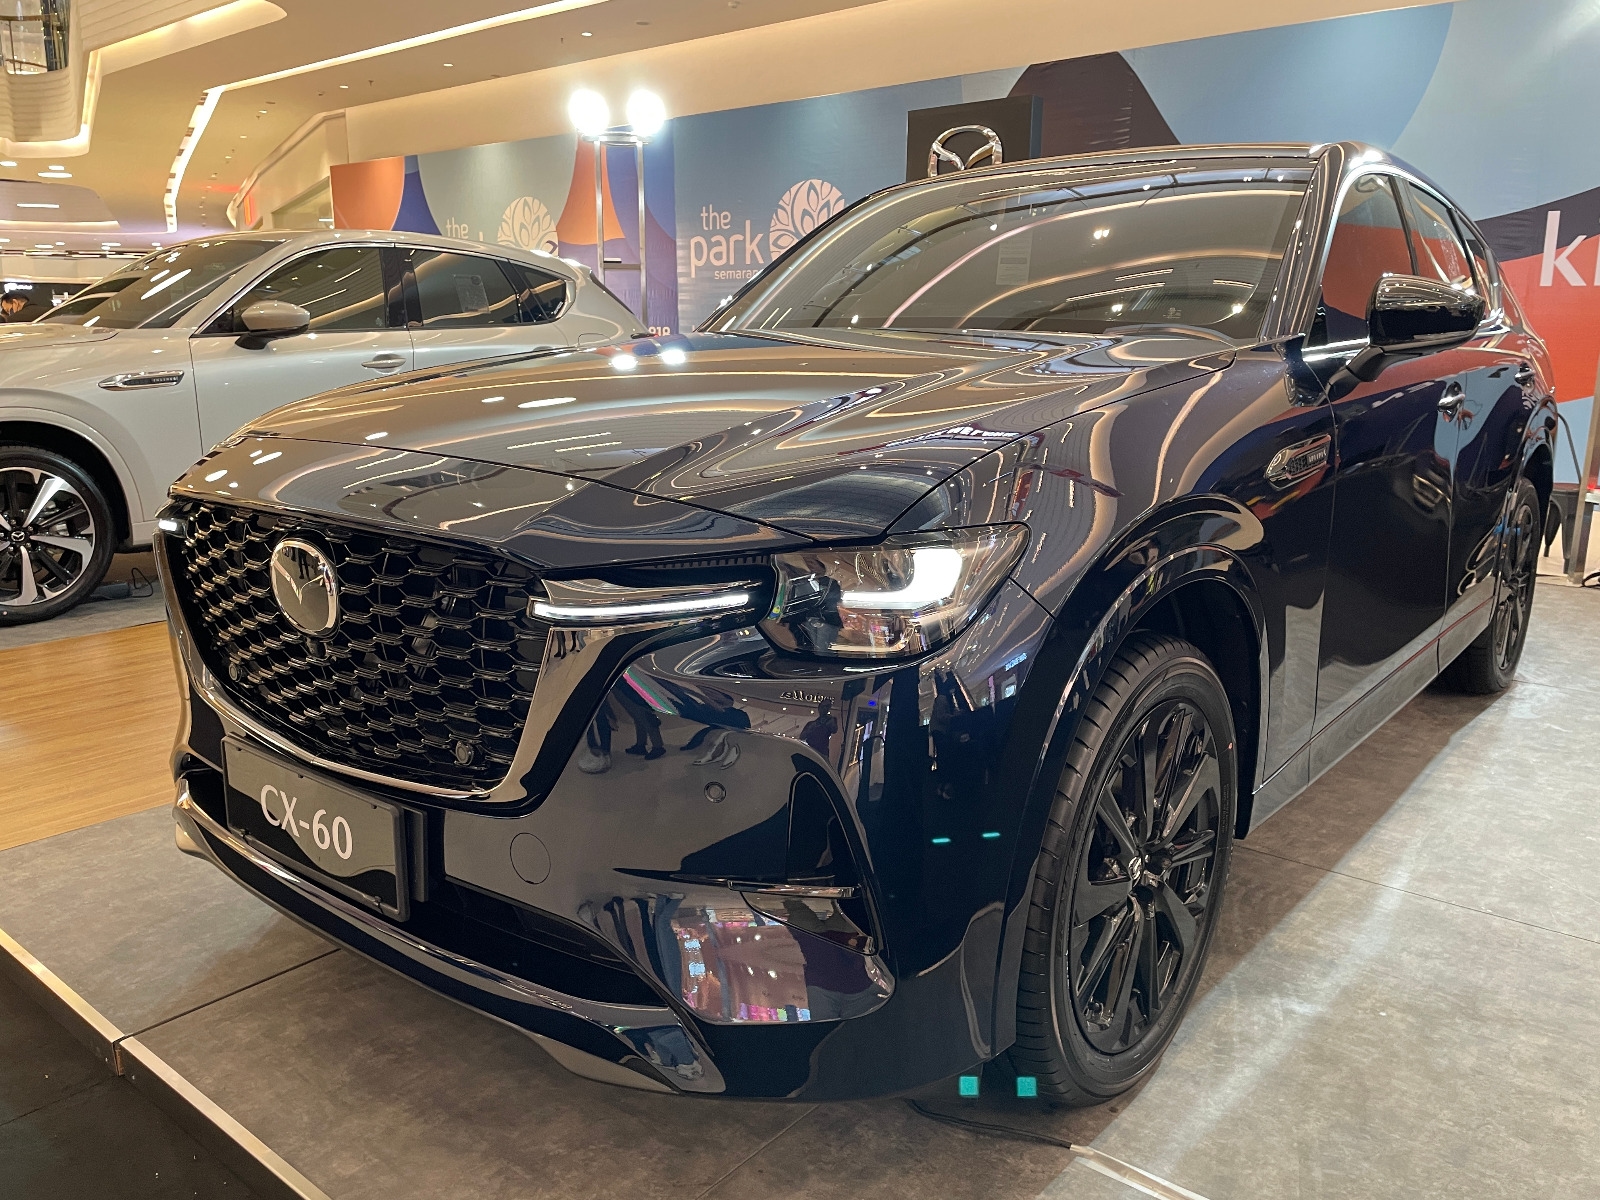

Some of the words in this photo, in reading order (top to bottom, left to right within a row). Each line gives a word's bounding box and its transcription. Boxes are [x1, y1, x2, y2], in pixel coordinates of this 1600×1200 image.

[446, 216, 469, 240] the
[701, 204, 731, 230] the
[690, 220, 765, 279] park
[714, 269, 759, 280] semaran
[260, 784, 353, 860] CX-60
